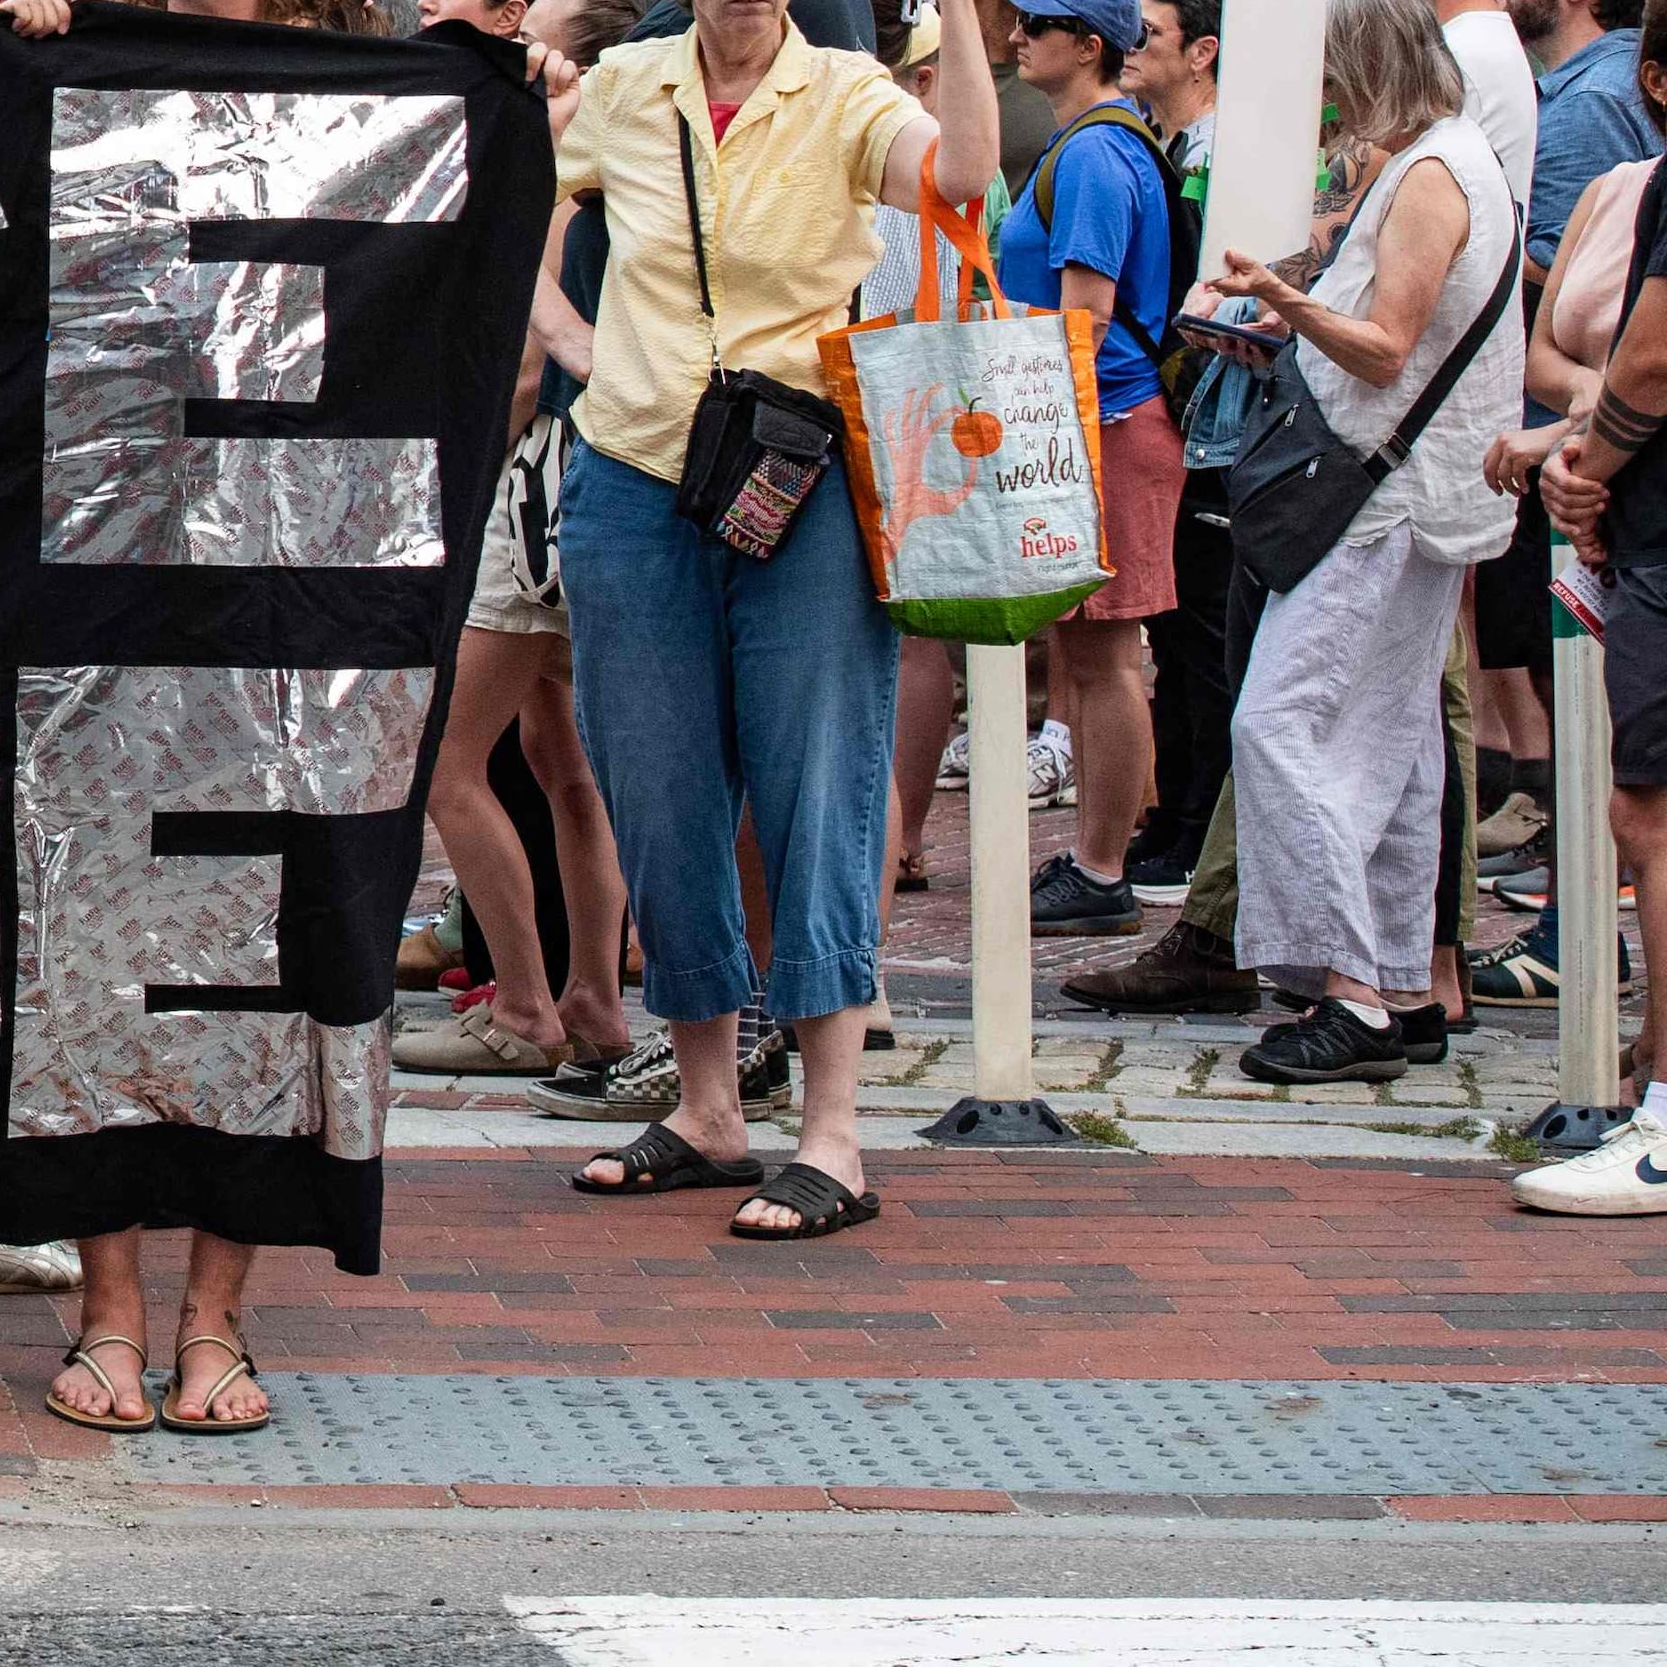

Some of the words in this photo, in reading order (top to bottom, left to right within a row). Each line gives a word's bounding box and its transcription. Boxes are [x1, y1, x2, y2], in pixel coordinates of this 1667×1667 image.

[1033, 379, 1055, 397] help
[1004, 402, 1068, 434] change
[1019, 432, 1038, 452] the
[995, 437, 1084, 494] world.
[1020, 533, 1078, 559] helps
